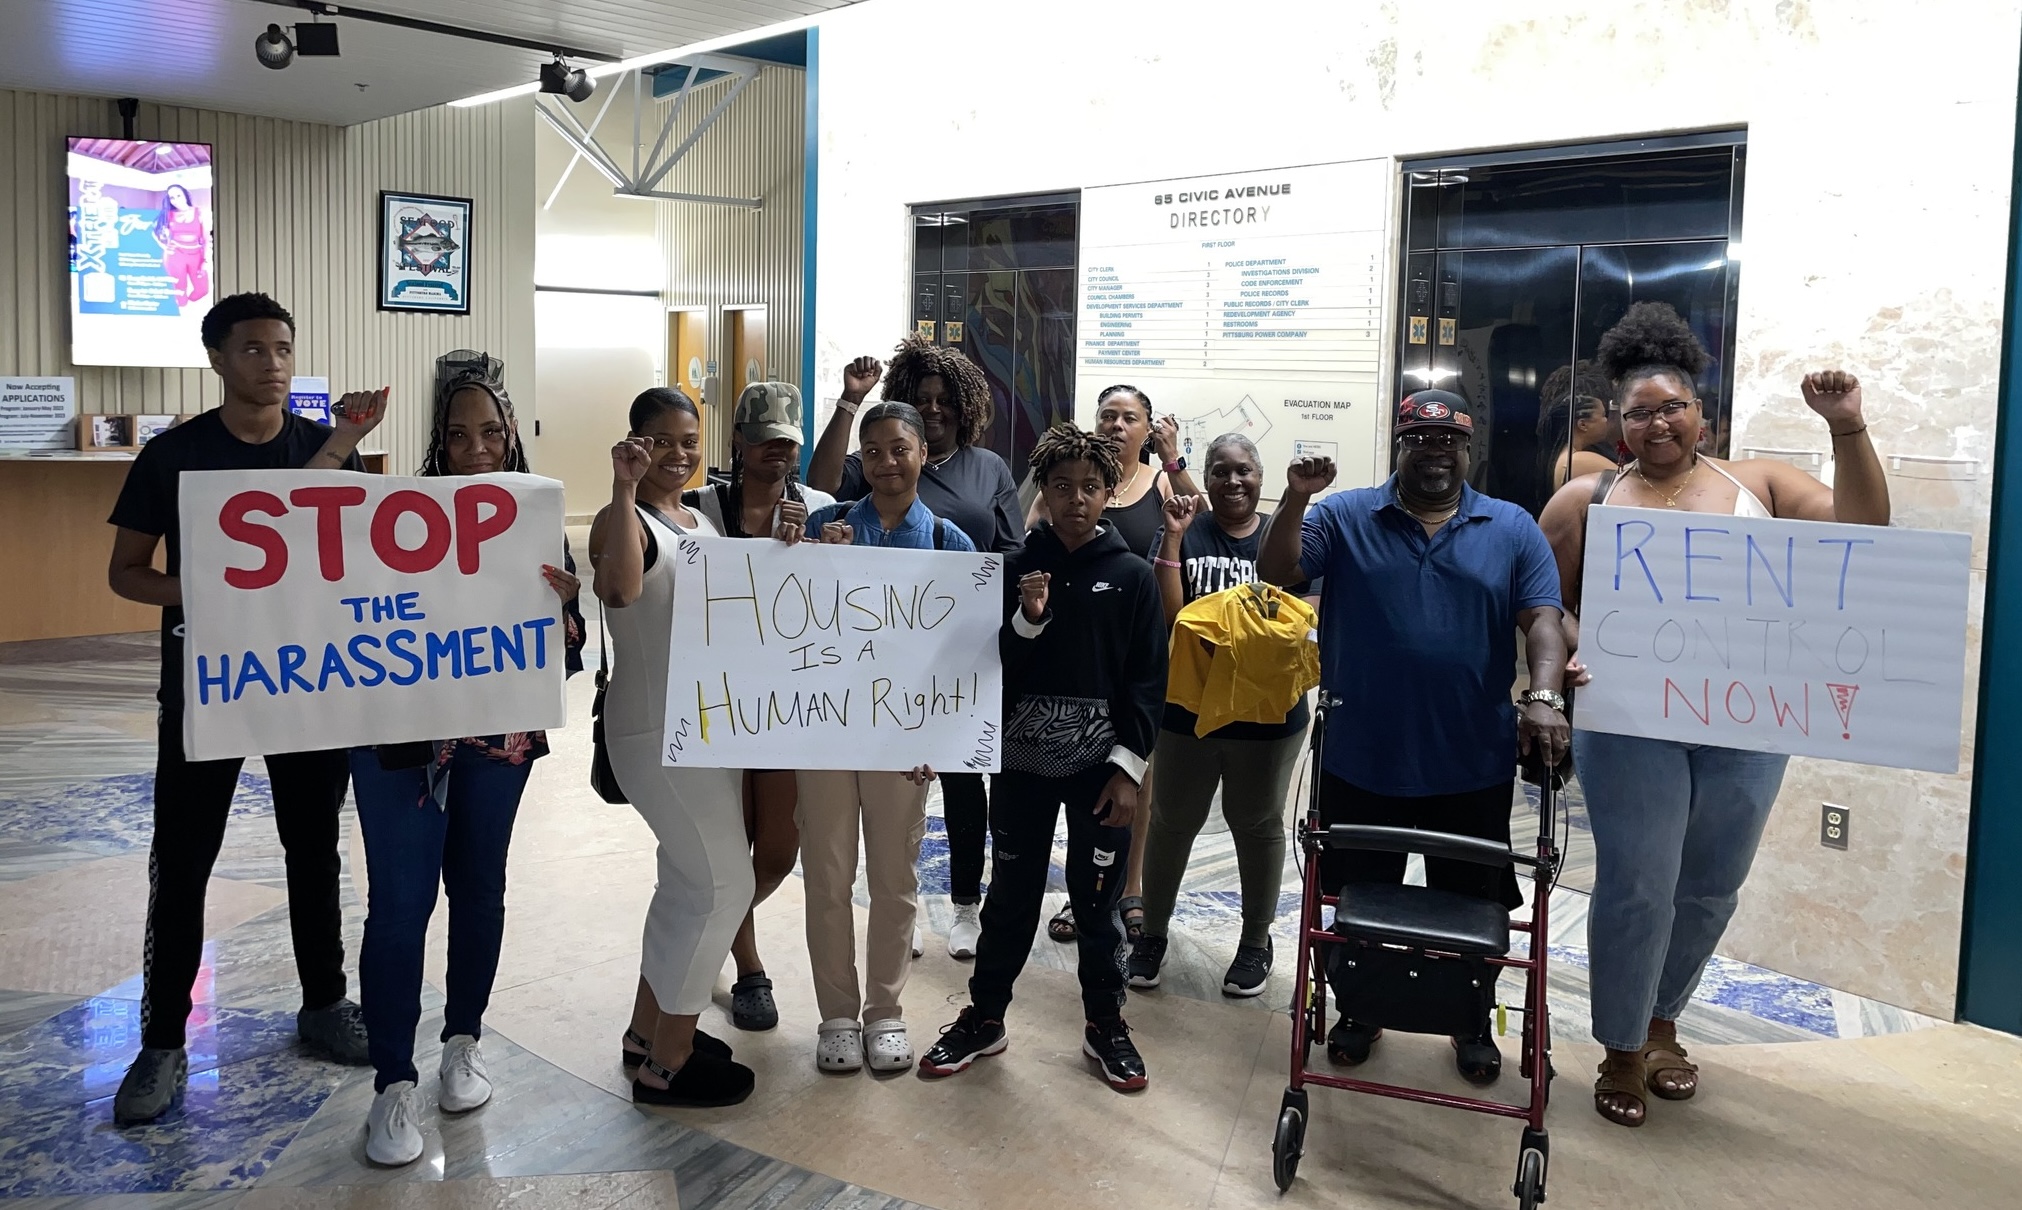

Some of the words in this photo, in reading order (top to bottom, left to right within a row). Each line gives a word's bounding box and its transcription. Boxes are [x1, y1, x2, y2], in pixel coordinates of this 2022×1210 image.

[1154, 193, 1173, 206] 65
[1178, 189, 1219, 204] CIVIC
[1224, 183, 1291, 199] AVENUE
[1170, 205, 1271, 229] DIRECTORY
[1218, 240, 1236, 248] FLOOR
[2, 394, 65, 402] APPLICATIONS
[25, 384, 60, 392] Accepting
[1284, 399, 1331, 409] EVACUATION
[218, 483, 518, 590] STOP
[1613, 520, 1875, 610] RENT
[340, 591, 426, 623] THE
[704, 553, 956, 646] HOUSING
[196, 617, 556, 706] HARASSMENT
[789, 642, 842, 672] IS
[857, 640, 875, 662] A
[1596, 610, 1936, 686] CONTROL
[696, 671, 850, 739] HUMAN
[872, 672, 977, 731] Right!
[1664, 677, 1860, 740] NOW!
